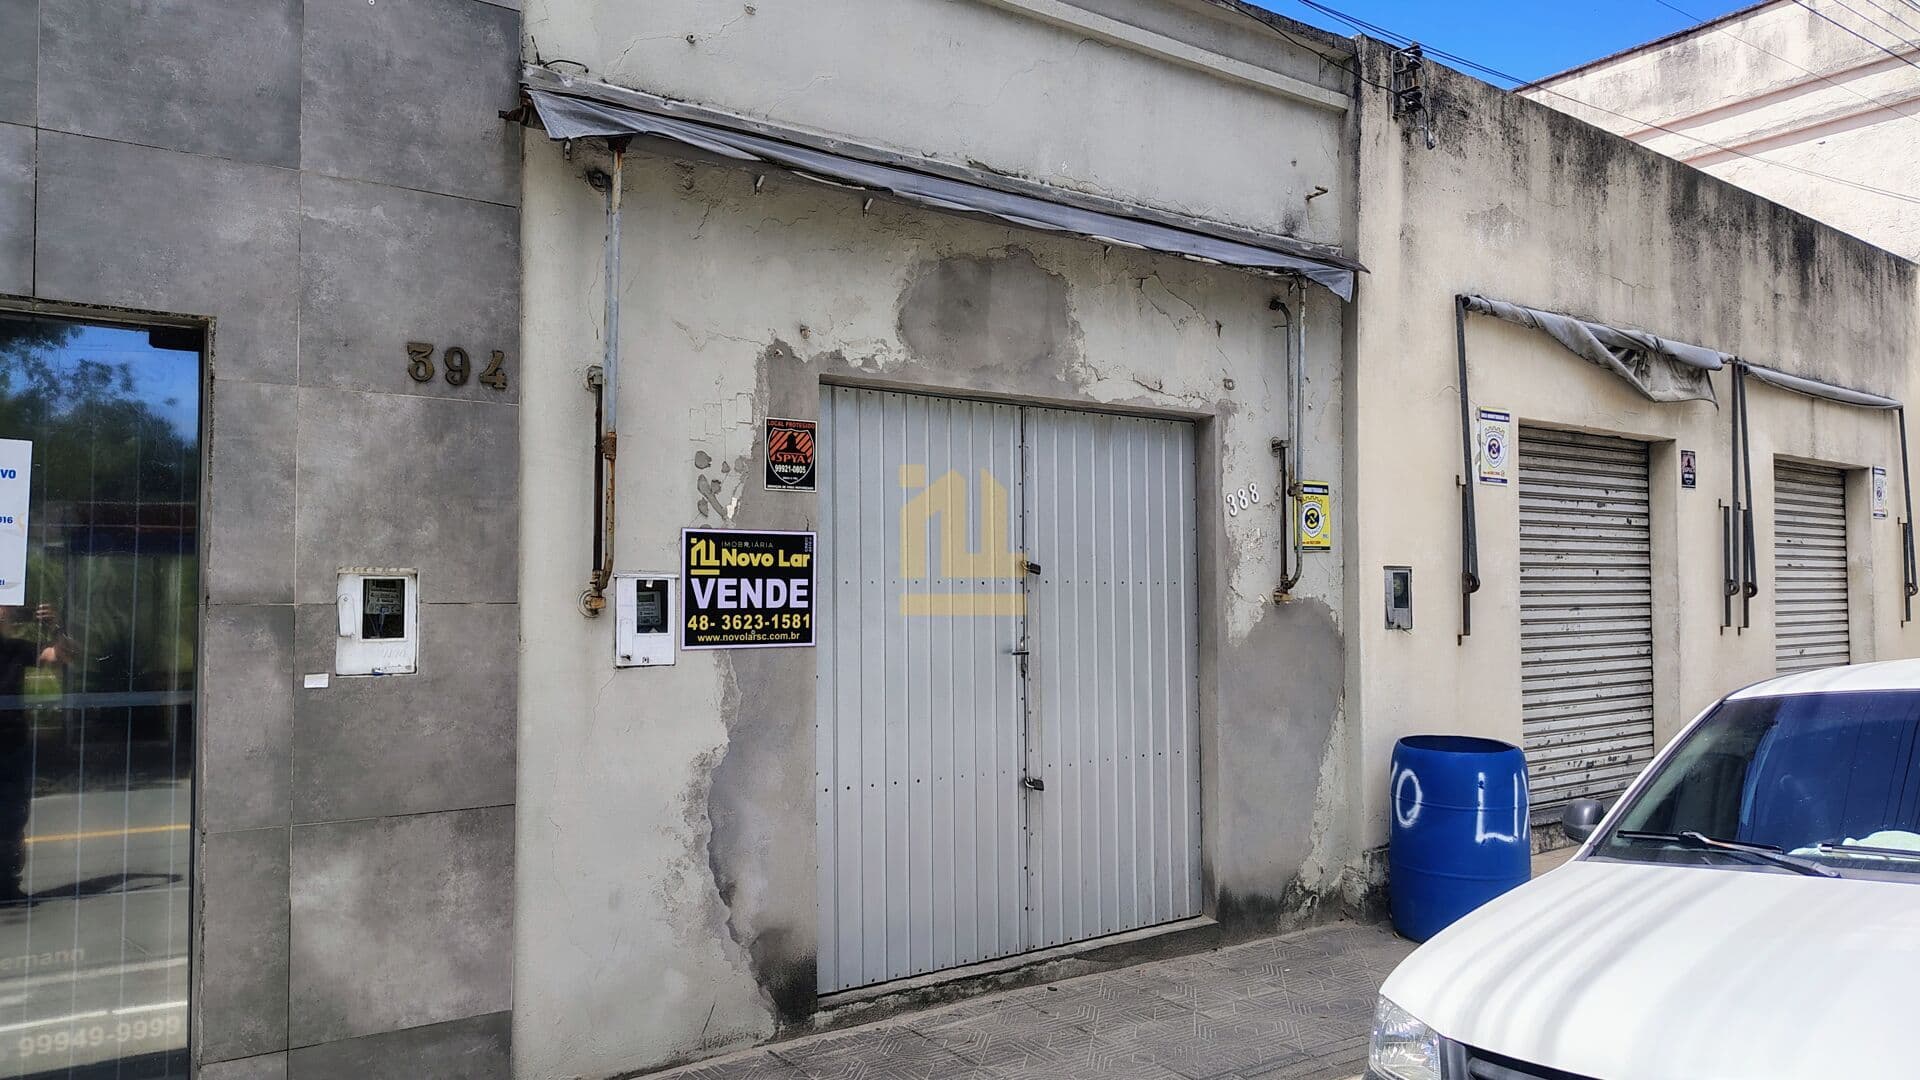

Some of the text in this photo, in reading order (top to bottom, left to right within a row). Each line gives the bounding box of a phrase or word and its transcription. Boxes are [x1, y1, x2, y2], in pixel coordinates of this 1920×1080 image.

[407, 342, 507, 389] 394
[776, 453, 805, 463] SPYA
[1226, 483, 1259, 516] 388
[722, 548, 810, 567] Novo Lar
[690, 578, 808, 609] VENDE
[721, 613, 810, 630] 3623-1581
[697, 631, 800, 642] www.novolarsc.com.br
